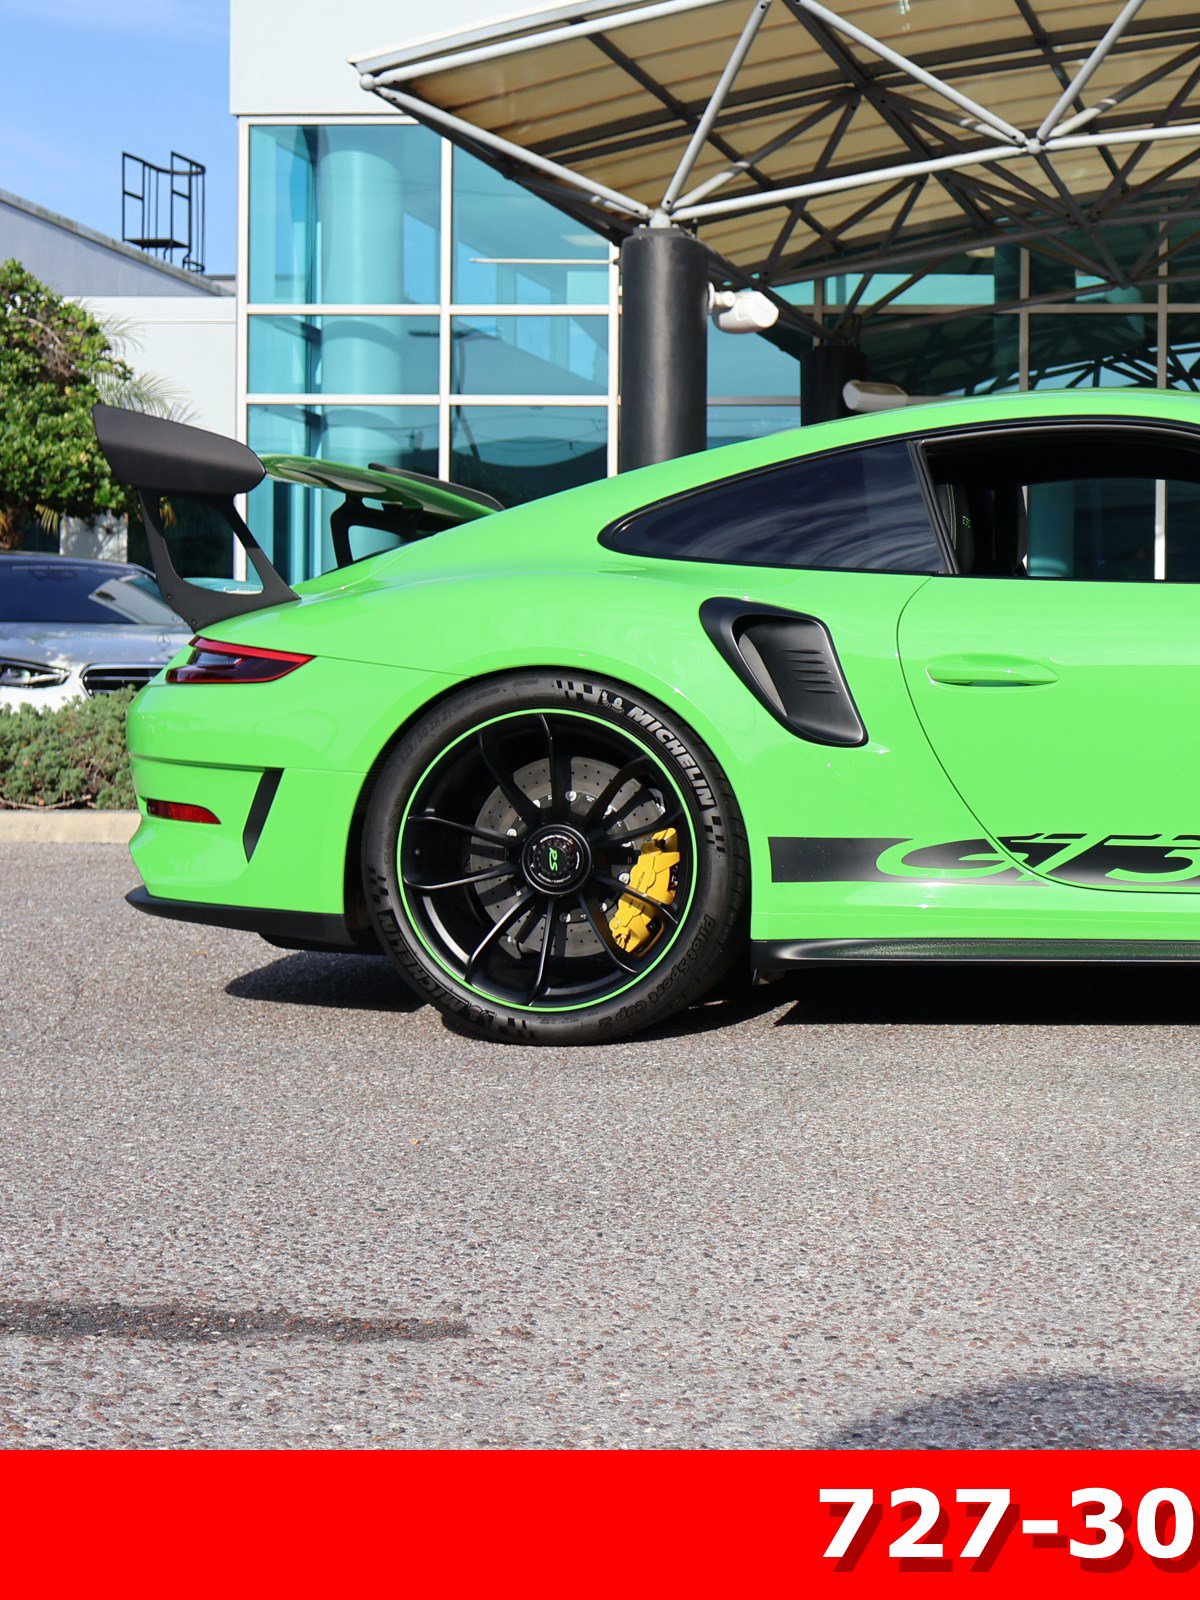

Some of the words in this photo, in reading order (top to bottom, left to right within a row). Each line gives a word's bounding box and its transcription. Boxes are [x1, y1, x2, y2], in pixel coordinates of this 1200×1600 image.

[626, 705, 716, 809] MICHELIN
[548, 847, 558, 872] RS
[684, 913, 717, 961] Pilot
[376, 909, 464, 1015] MICHELIN
[646, 956, 693, 1005] Sport
[597, 1015, 616, 1032] 2
[613, 996, 650, 1025] Cup
